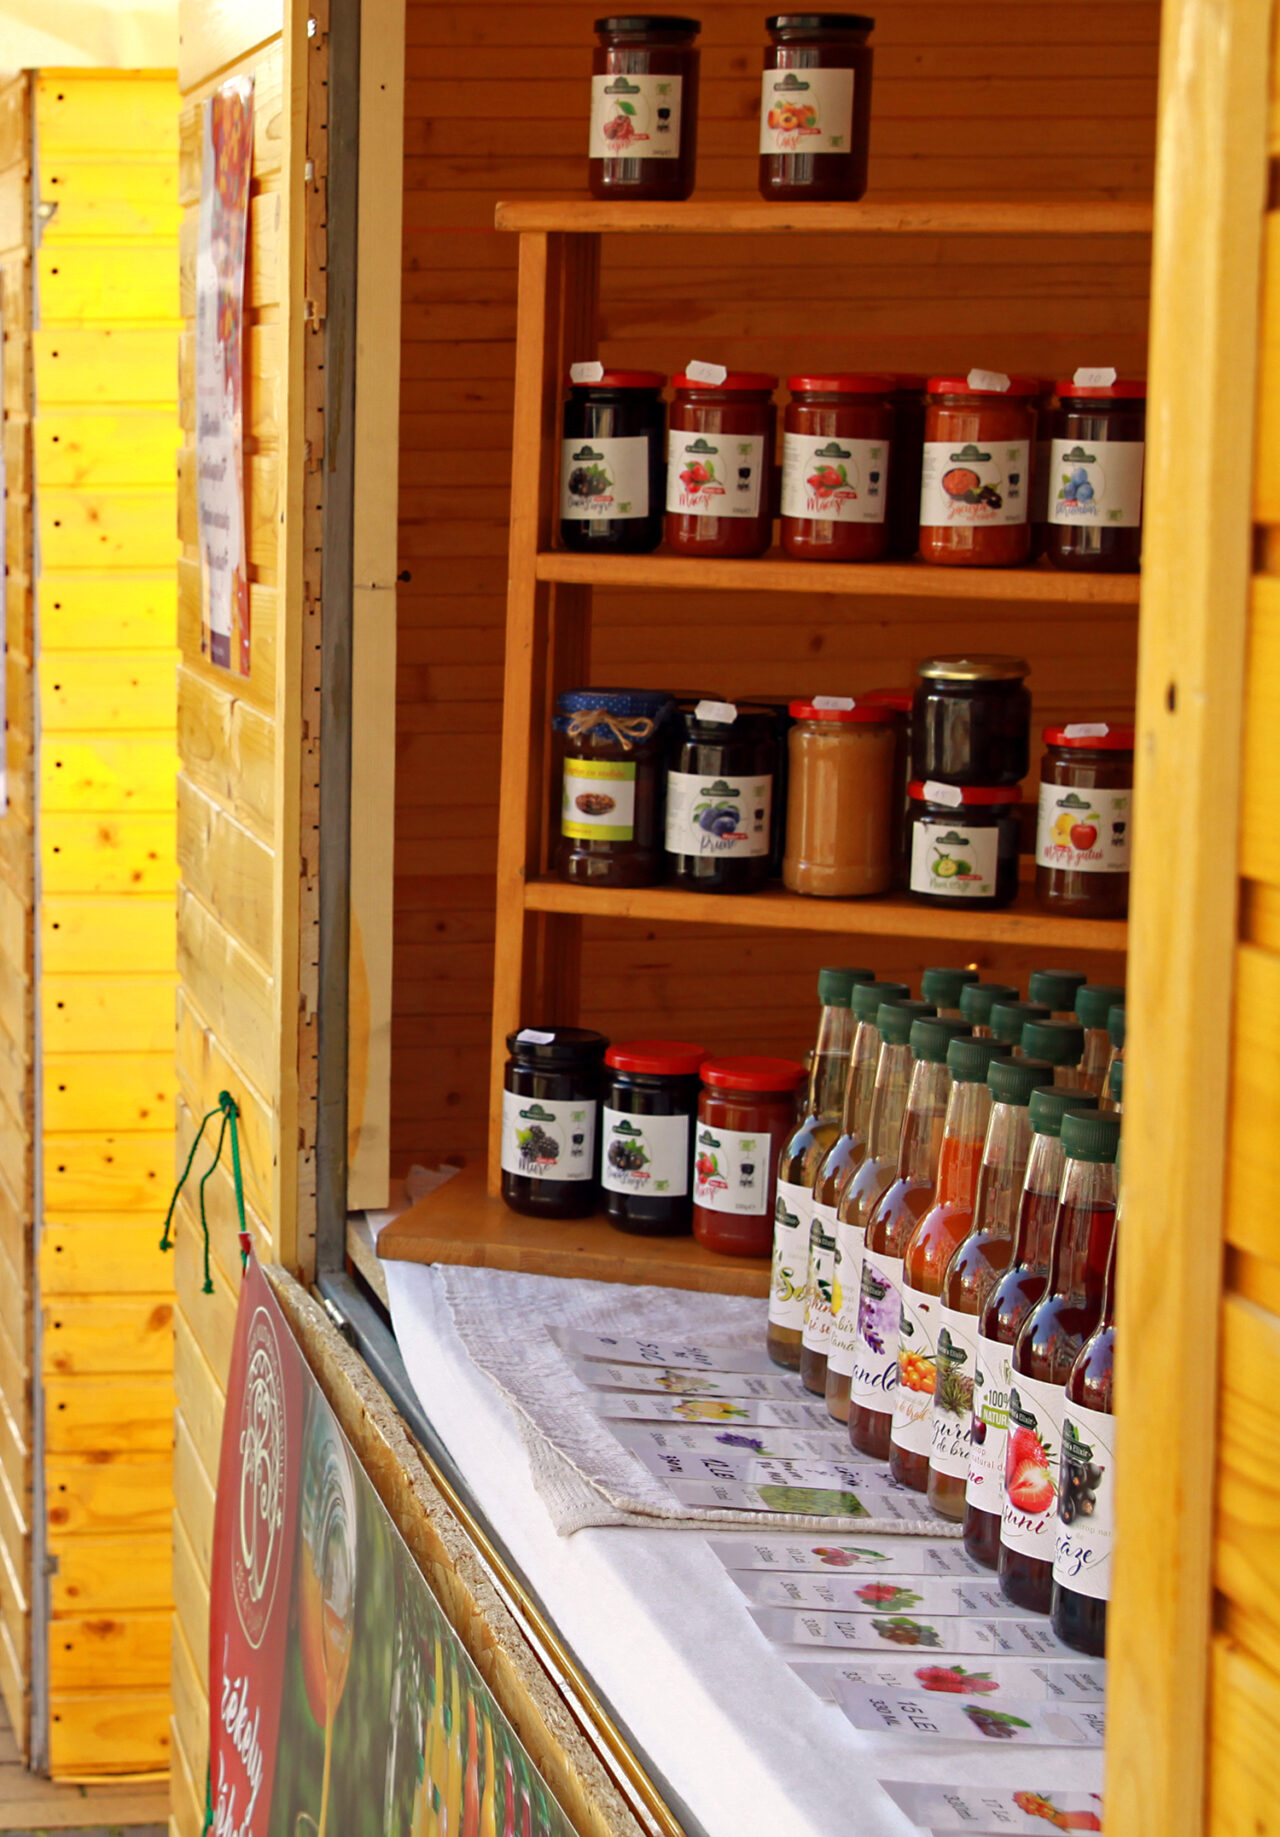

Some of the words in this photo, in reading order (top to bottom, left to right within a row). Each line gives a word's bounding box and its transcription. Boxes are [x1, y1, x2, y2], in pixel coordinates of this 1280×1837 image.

[869, 1698, 891, 1713] 330
[881, 1714, 899, 1726] ML
[897, 1701, 923, 1713] 15
[908, 1715, 941, 1732] LEI
[943, 1794, 977, 1820] 330ml
[981, 1798, 1003, 1809] 17
